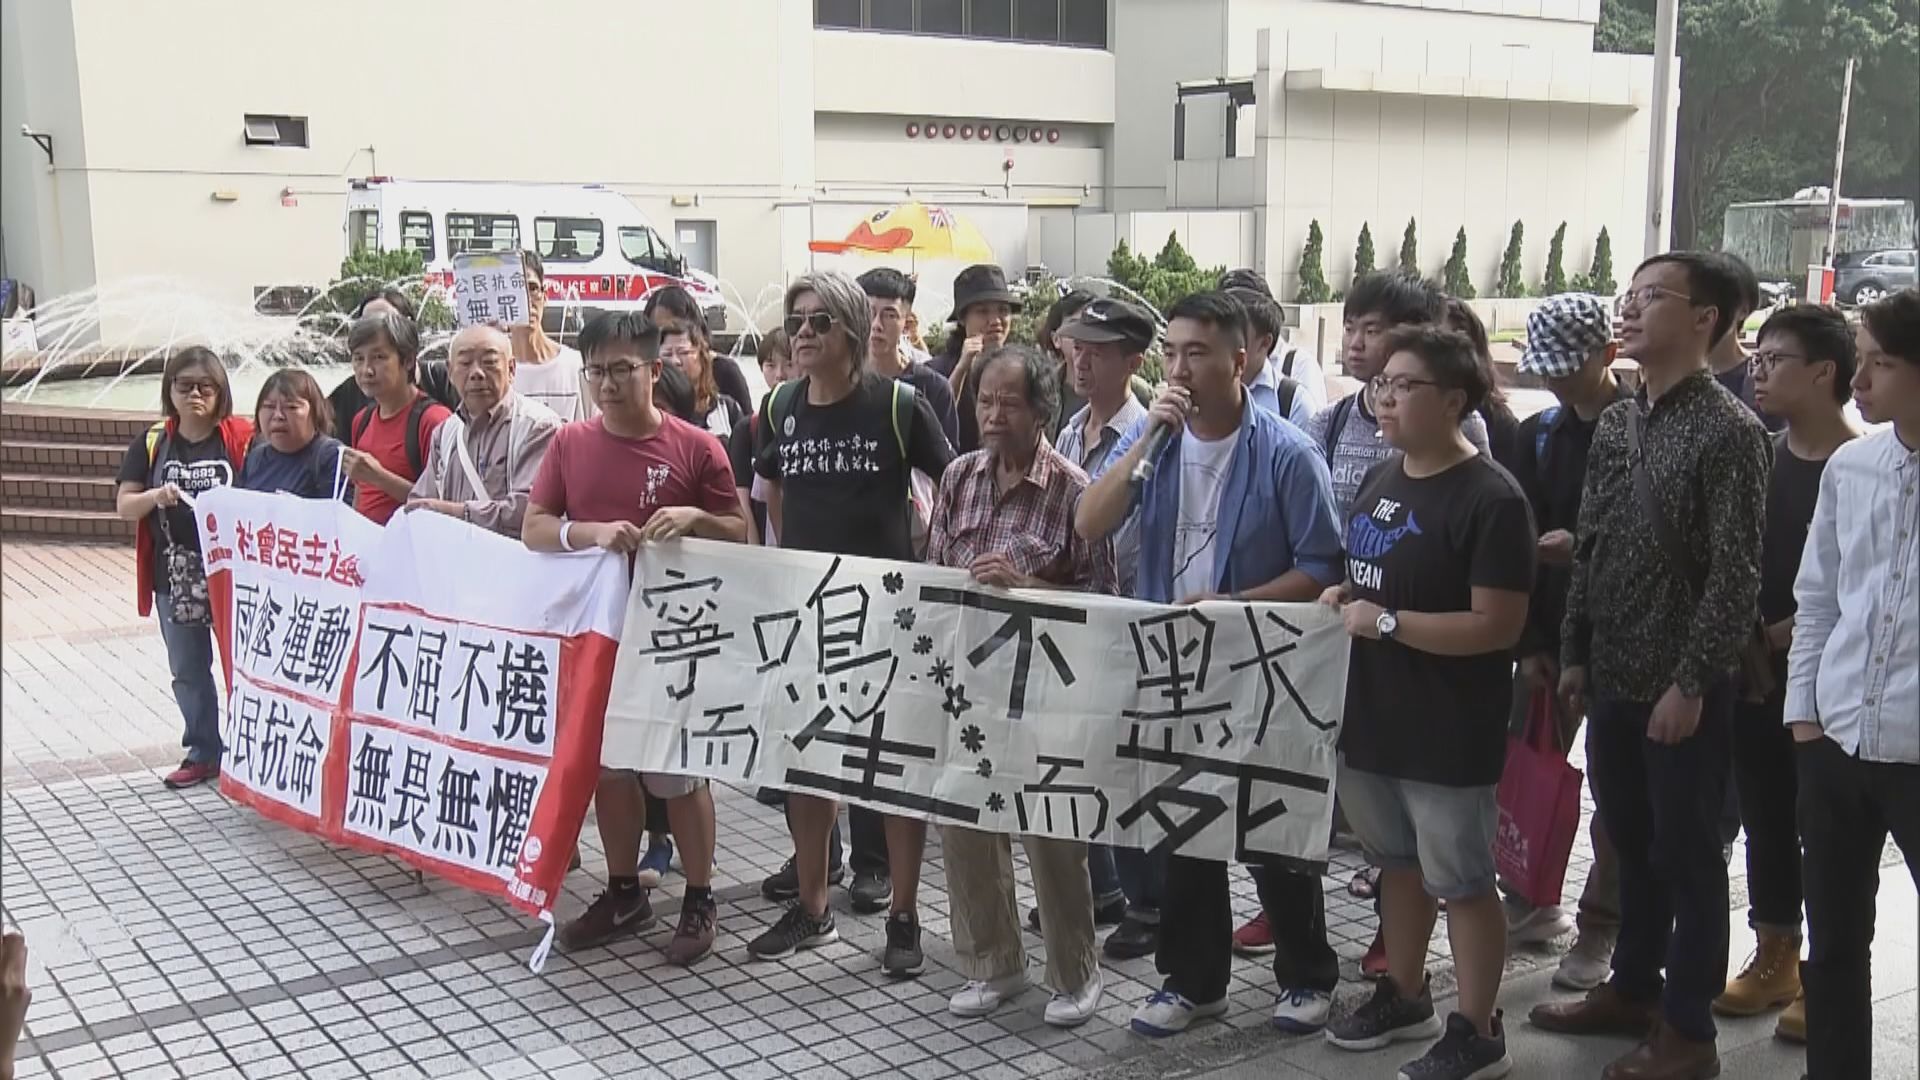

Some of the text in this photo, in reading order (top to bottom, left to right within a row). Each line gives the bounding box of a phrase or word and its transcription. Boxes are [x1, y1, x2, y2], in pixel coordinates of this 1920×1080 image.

[455, 271, 524, 293] 公民抗命
[544, 279, 586, 294] POLICE
[467, 294, 519, 323] 無罪
[1372, 497, 1401, 521] THE
[233, 583, 351, 694] 雨傘運動
[361, 621, 550, 744] 不屈不撓
[348, 733, 538, 869] 無畏無懼
